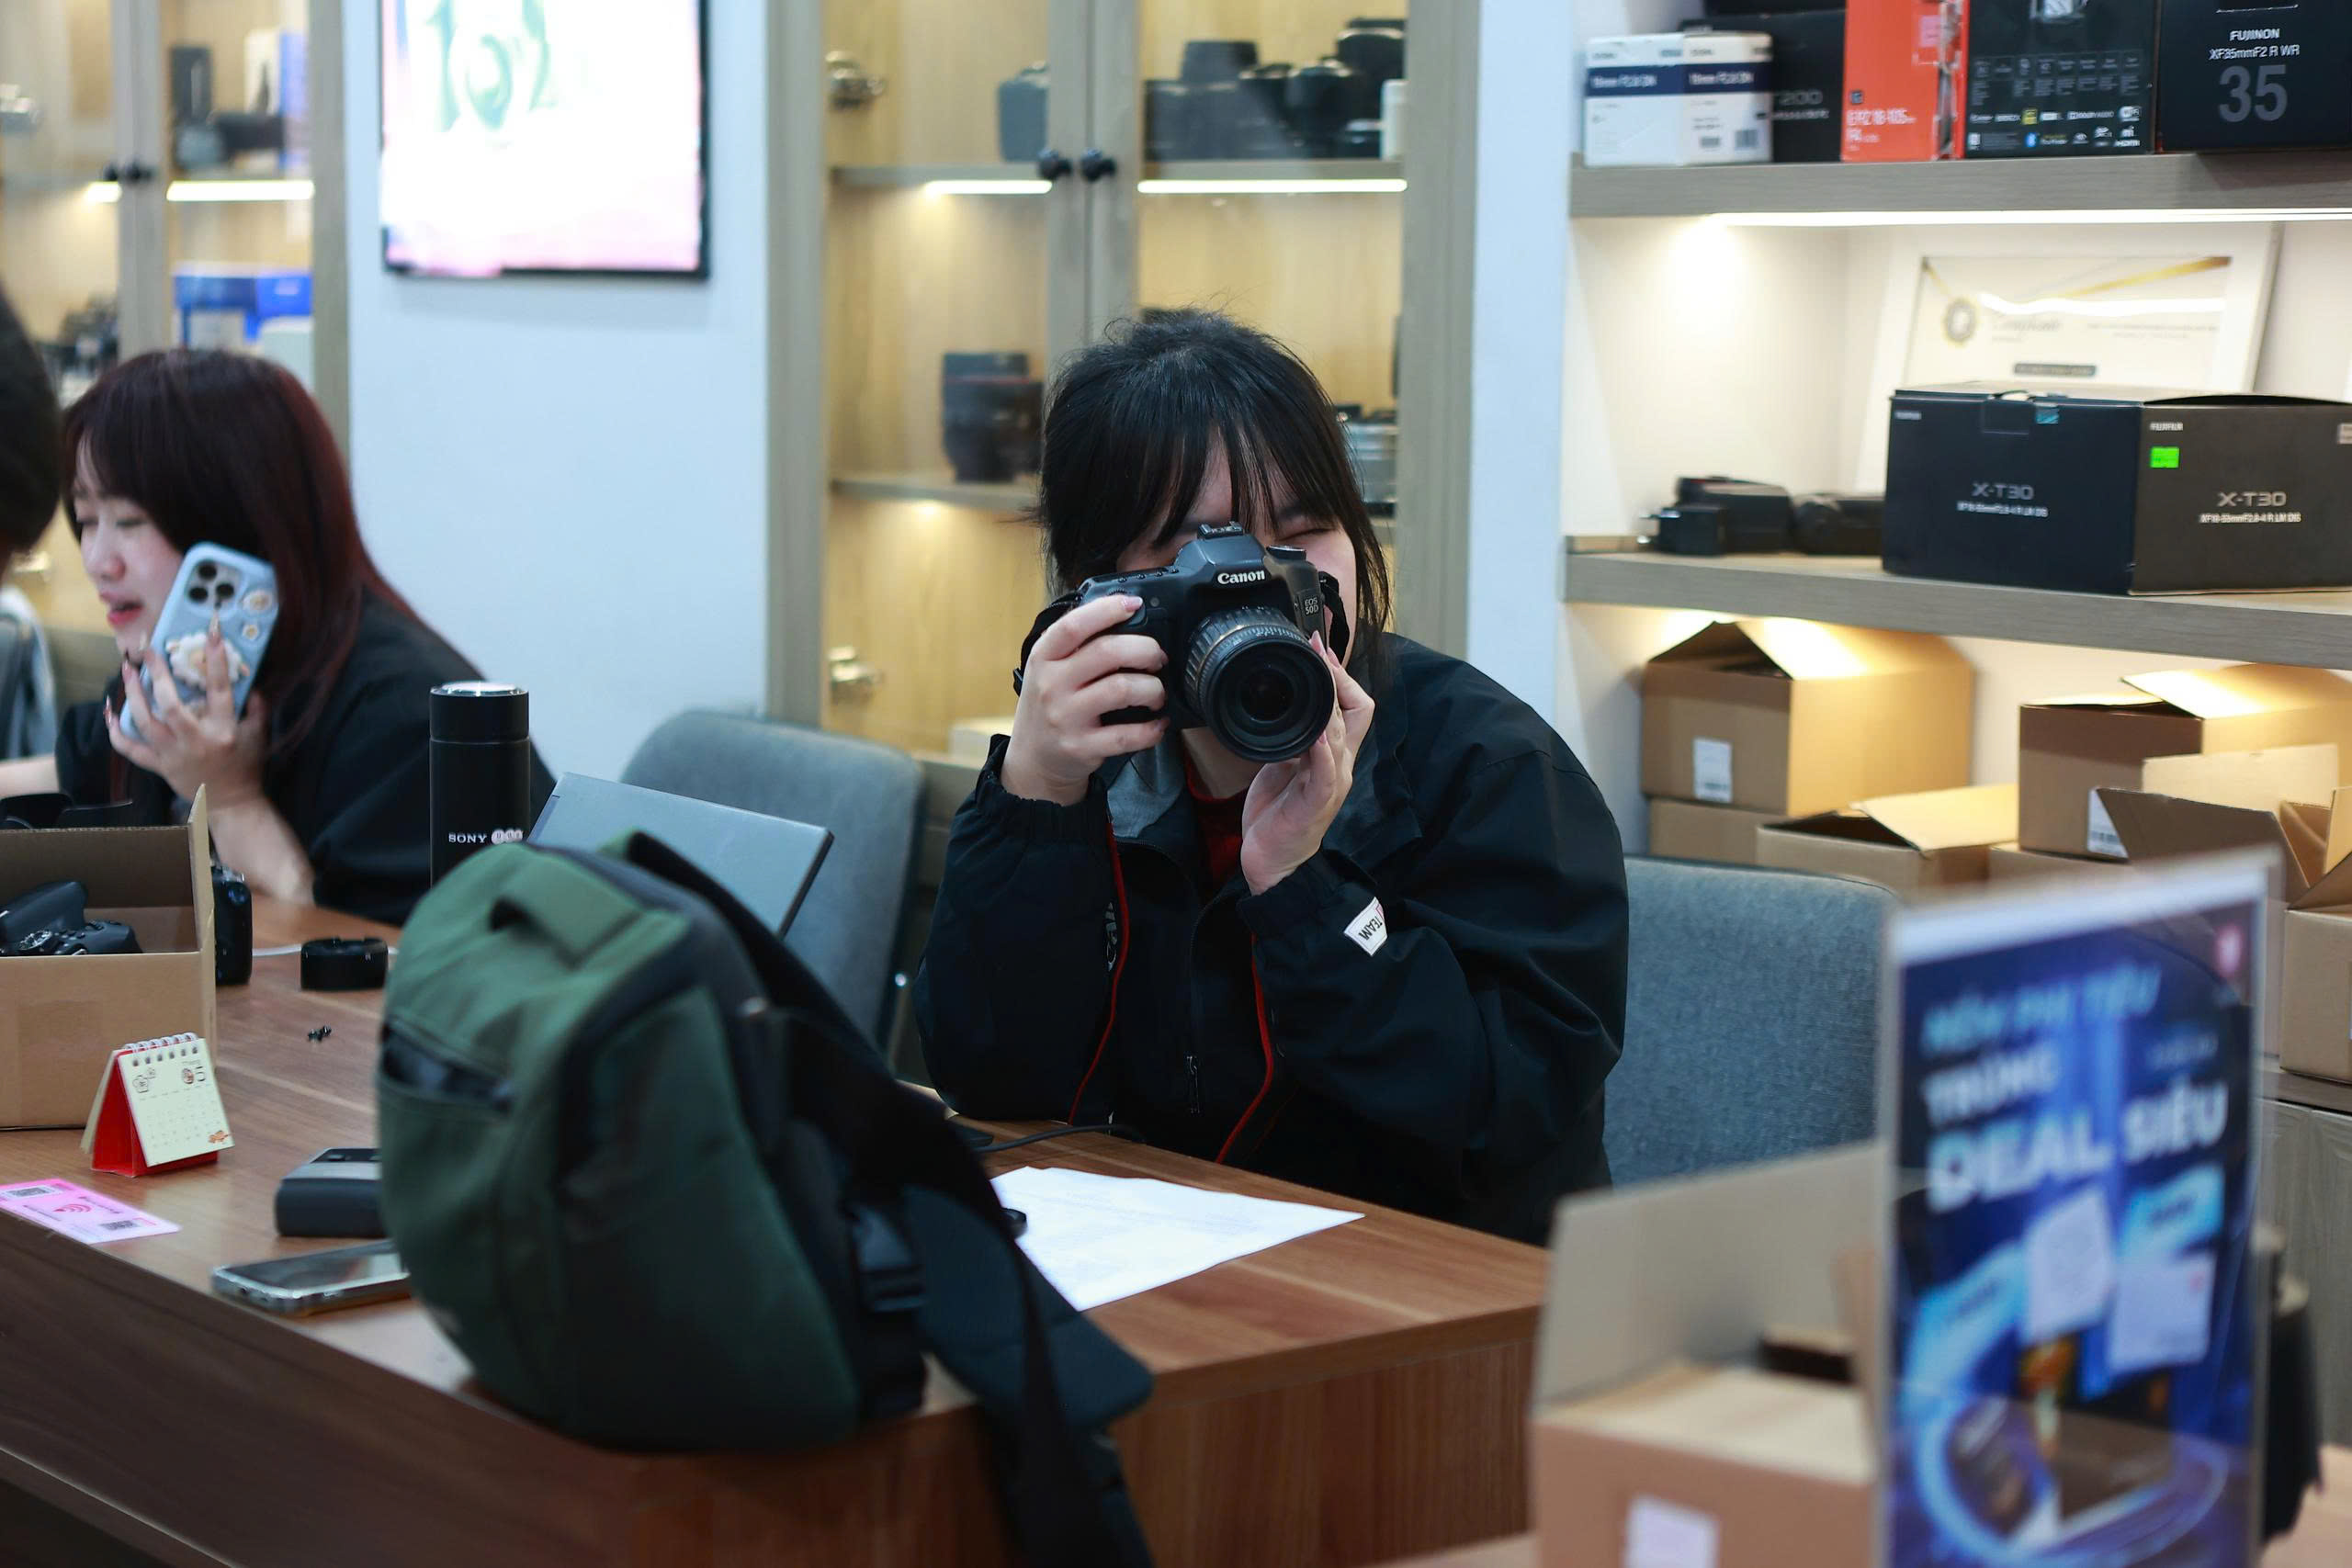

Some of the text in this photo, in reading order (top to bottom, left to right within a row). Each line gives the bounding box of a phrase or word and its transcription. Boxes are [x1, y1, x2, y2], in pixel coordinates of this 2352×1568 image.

[2230, 28, 2280, 41] FUJINON
[2209, 44, 2301, 60] XF35mmF2 R WR
[2219, 64, 2288, 122] 35
[1972, 482, 2034, 501] X-T30
[2217, 491, 2287, 507] X-T30
[1217, 570, 1265, 585] Canon
[1305, 597, 1318, 606] EOS
[1305, 604, 1319, 615] 50D
[448, 832, 487, 843] SONY
[1358, 915, 1383, 941] TEAM
[1928, 1109, 2114, 1212] DEAL
